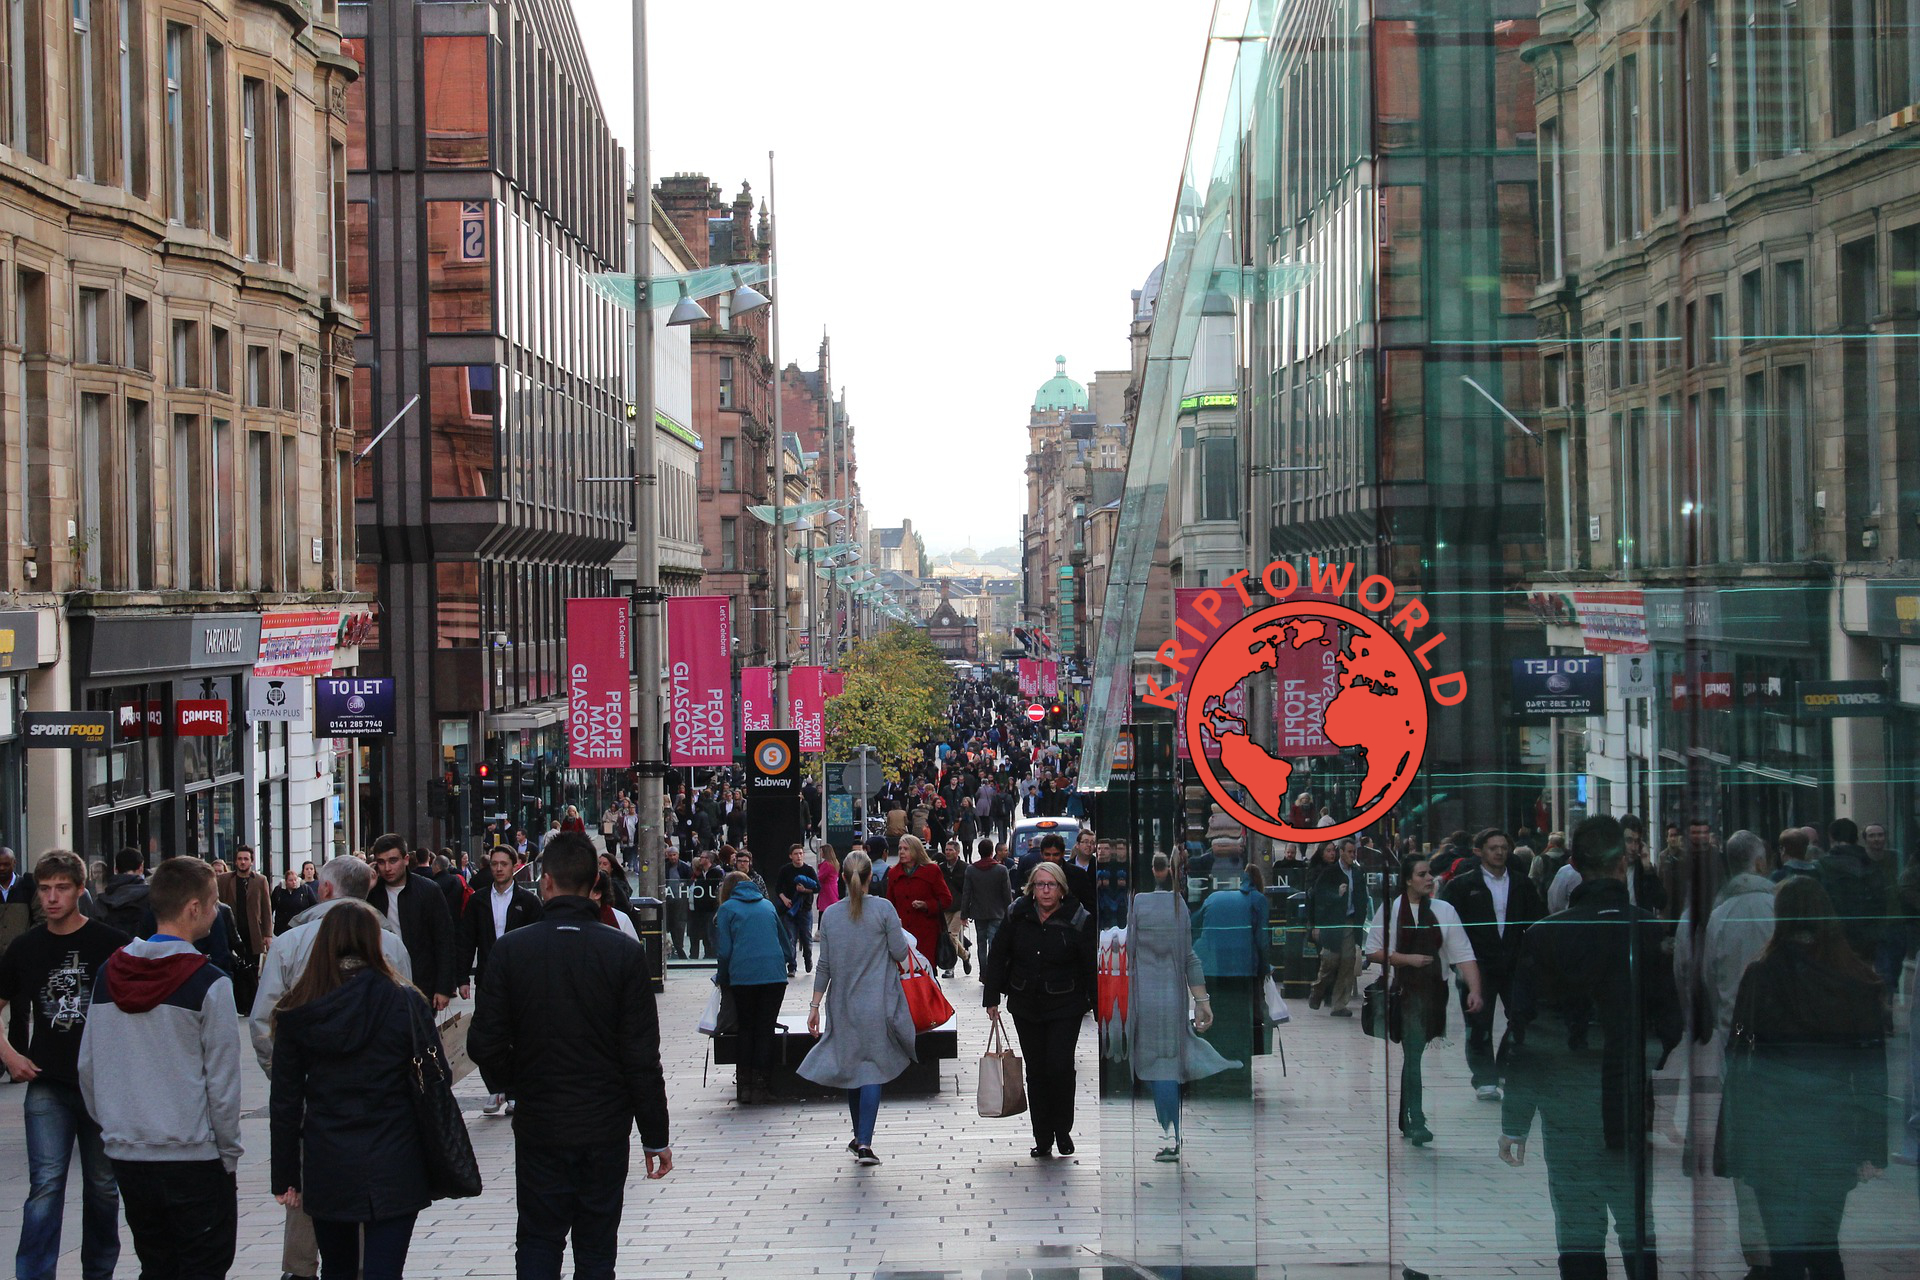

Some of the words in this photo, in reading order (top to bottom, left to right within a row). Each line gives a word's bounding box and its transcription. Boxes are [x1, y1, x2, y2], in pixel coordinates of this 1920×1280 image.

[205, 629, 228, 654] TARTAN
[228, 627, 242, 652] PLUS
[719, 622, 727, 657] Celebrate
[329, 681, 350, 695] TO
[354, 680, 383, 695] LET
[182, 710, 223, 725] CAMPER
[253, 709, 281, 717] TARTAN
[283, 709, 300, 718] PLUS
[365, 720, 383, 728] 7940
[571, 663, 589, 759] GLASGOW
[605, 690, 622, 758] PEOPLE
[673, 661, 691, 757] GLASGOW
[707, 688, 724, 756] PEOPLE
[30, 724, 105, 736] SPORTFOOD
[589, 706, 605, 758] MAKE
[691, 704, 708, 757] MAKE
[804, 720, 812, 747] MAKE
[812, 712, 821, 747] PEOPLE
[754, 777, 791, 788] Subway
